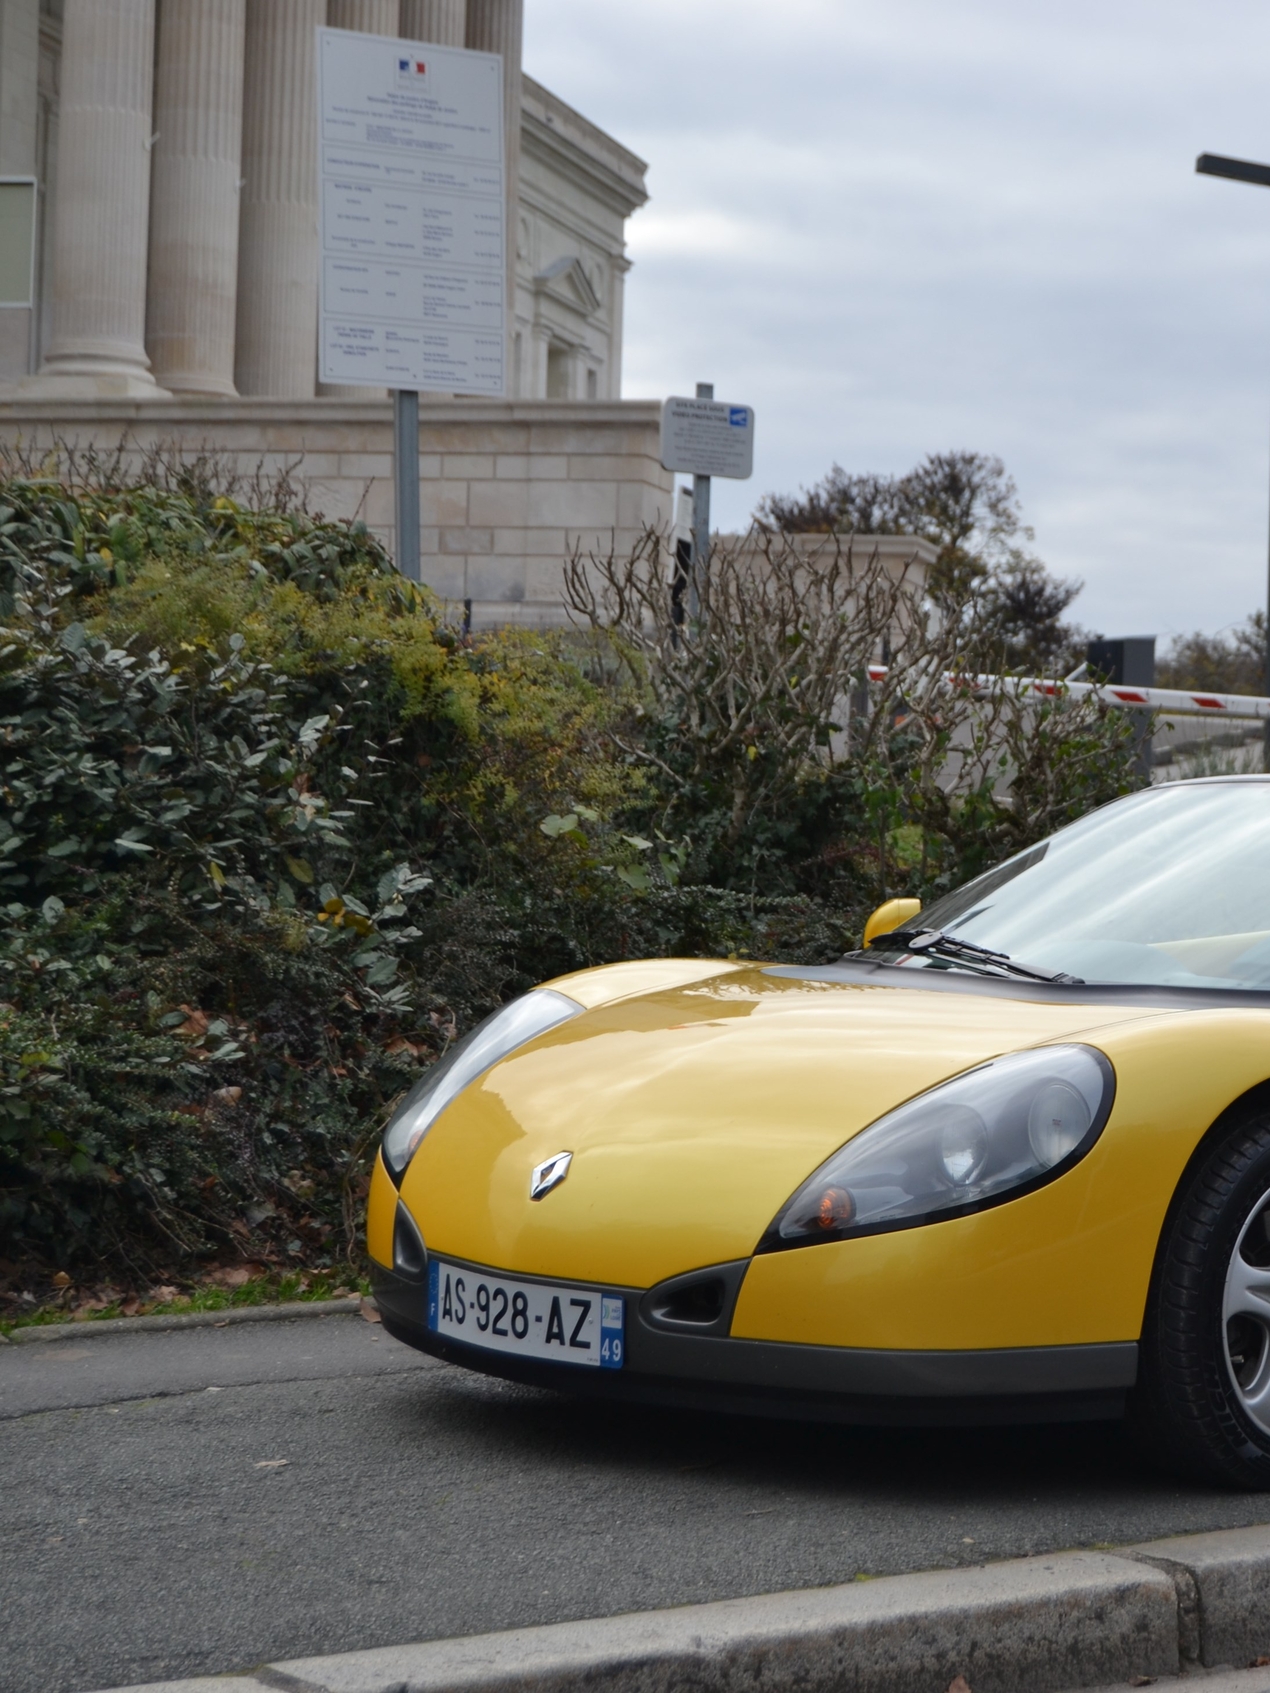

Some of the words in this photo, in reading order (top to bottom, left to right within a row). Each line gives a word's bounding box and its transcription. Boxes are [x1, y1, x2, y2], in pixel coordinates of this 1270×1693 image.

[430, 1302, 436, 1316] F
[442, 1273, 592, 1350] AS-928-AZ
[601, 1338, 622, 1362] 49
